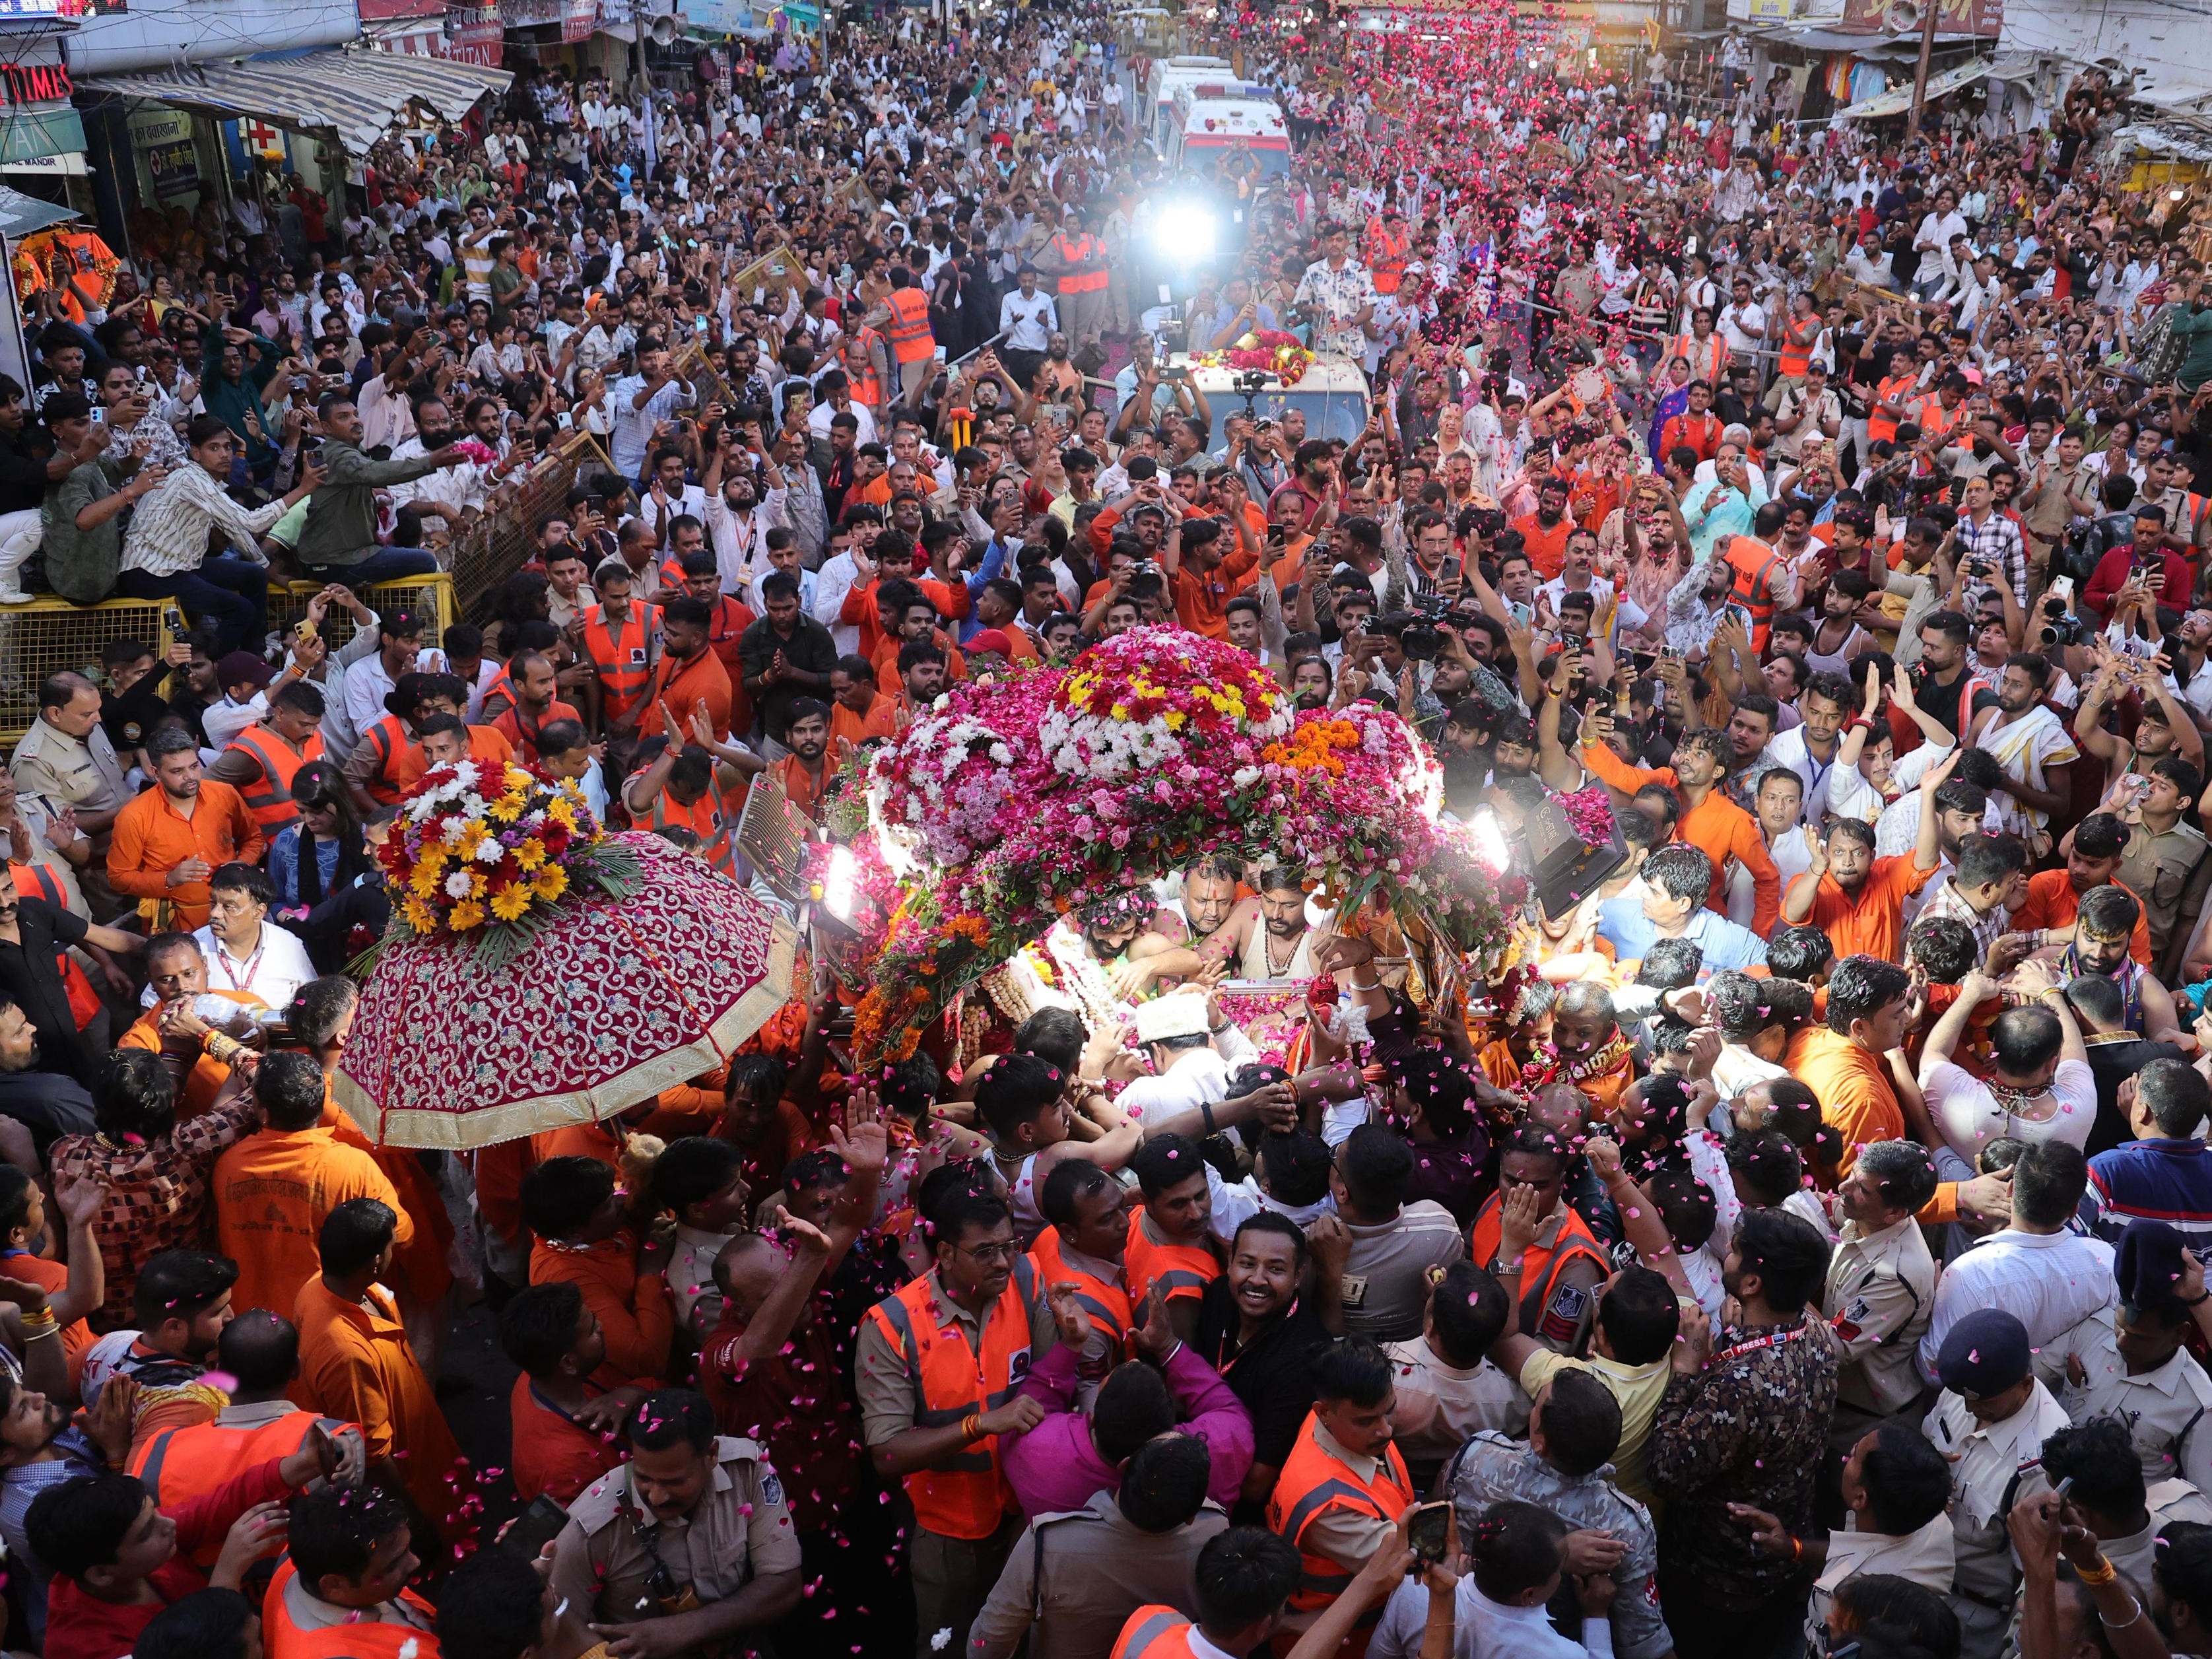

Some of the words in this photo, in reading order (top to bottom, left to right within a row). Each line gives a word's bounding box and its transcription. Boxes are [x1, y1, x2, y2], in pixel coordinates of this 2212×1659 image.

[454, 44, 490, 66] TITAN
[24, 157, 56, 166] MANDIR
[1736, 1337, 1767, 1353] PRESS
